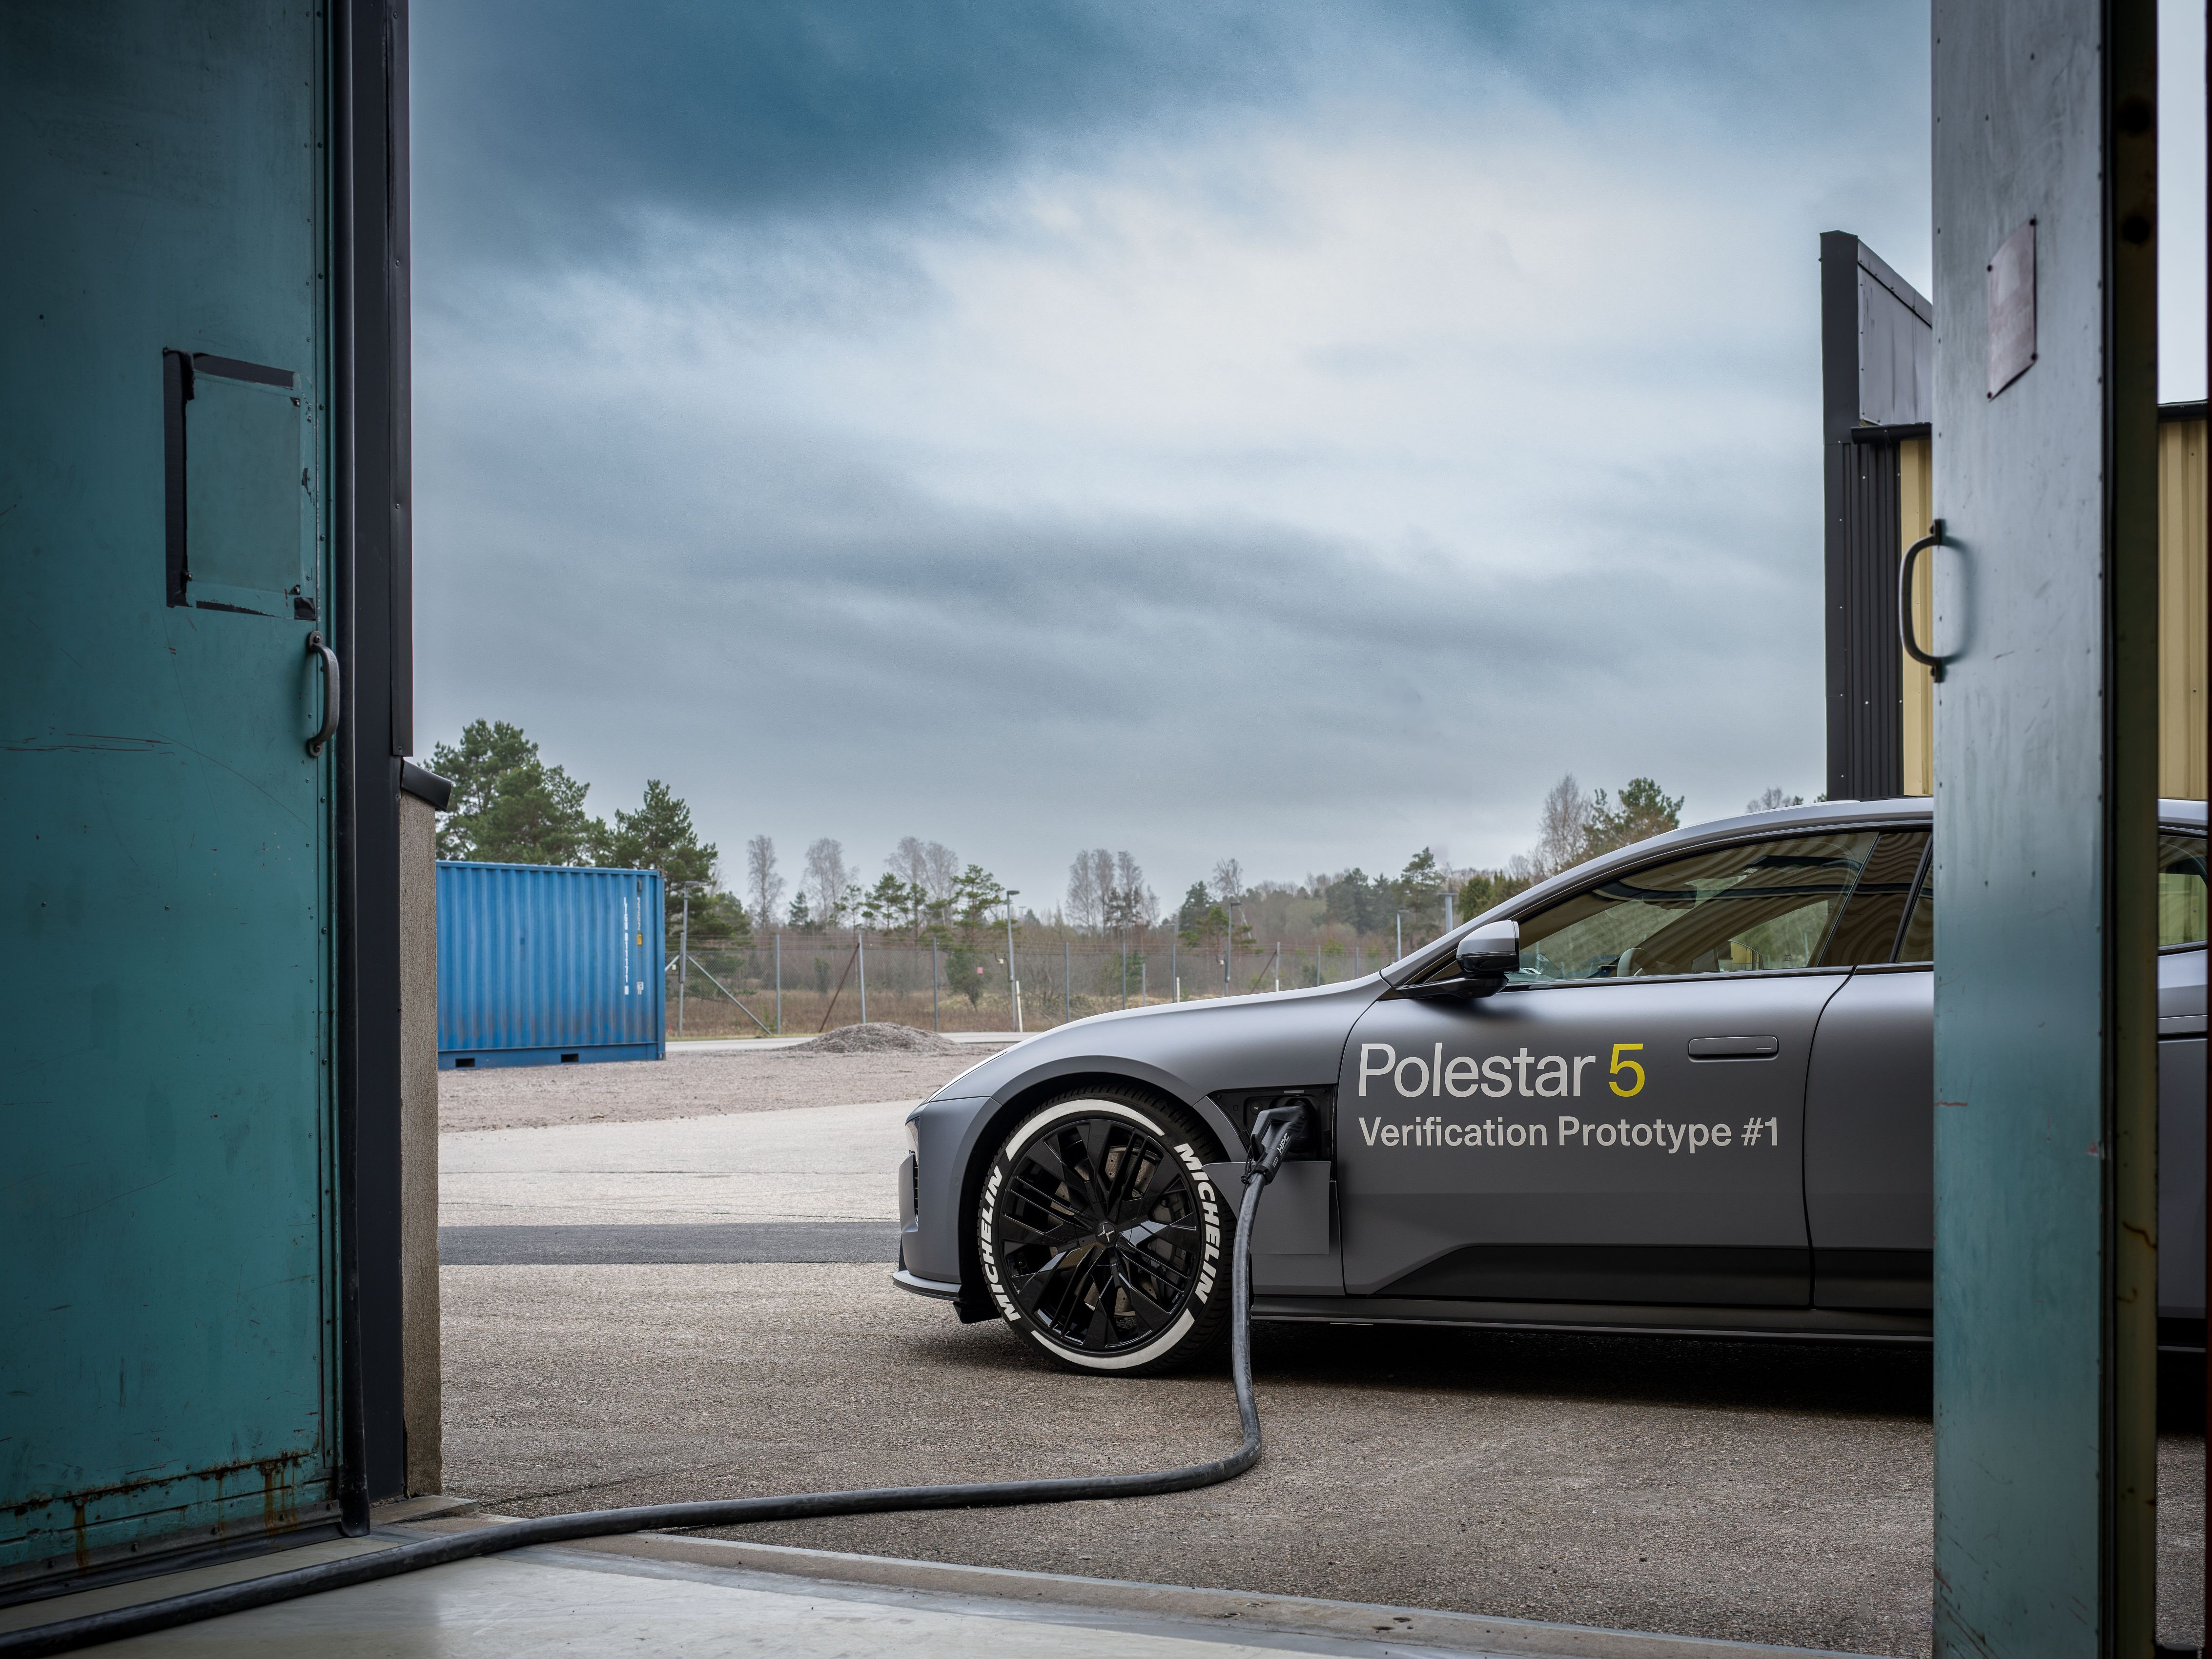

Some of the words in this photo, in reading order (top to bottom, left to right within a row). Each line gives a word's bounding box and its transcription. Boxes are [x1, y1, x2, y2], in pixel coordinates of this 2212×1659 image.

[1358, 1043, 1596, 1098] Polestar
[1609, 1043, 1645, 1098] 5
[1277, 1132, 1290, 1153] HPC
[1358, 1116, 1548, 1147] Verification
[1558, 1116, 1732, 1154] Prototype
[1741, 1117, 1778, 1147] #1
[979, 1165, 1021, 1321] MICHELIN
[1173, 1143, 1220, 1304] MICHELIN
